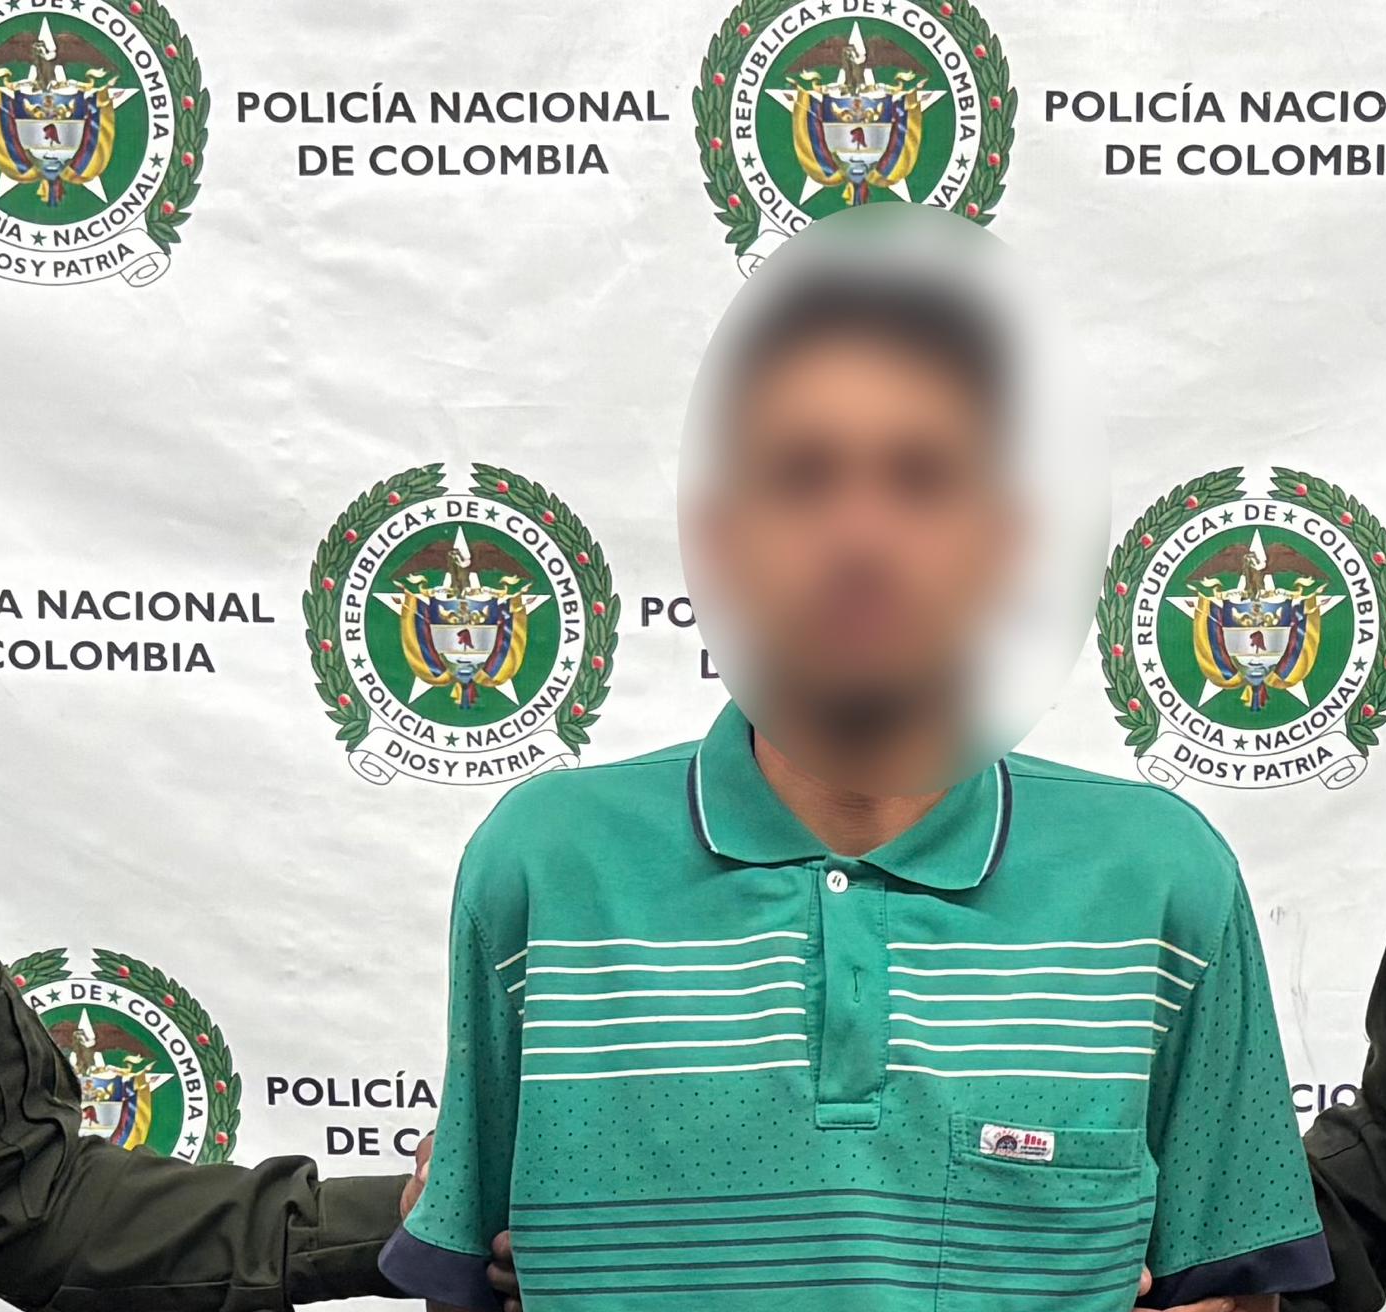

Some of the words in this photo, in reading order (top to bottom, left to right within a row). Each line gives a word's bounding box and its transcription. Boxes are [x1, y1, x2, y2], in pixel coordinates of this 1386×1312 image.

[92, 6, 169, 140] COLOMBIA
[238, 83, 416, 123] POLICÍA
[431, 90, 669, 123] NACIONAL
[1046, 83, 1225, 122] POLICÍA
[299, 145, 353, 176] DE
[369, 144, 608, 175] COLOMBIA
[1106, 145, 1161, 175] DE
[53, 172, 160, 247] NACIONAL
[53, 243, 135, 278] PATRIA
[446, 500, 479, 519] DE
[506, 516, 580, 644] COLOMBIA
[1244, 503, 1277, 521] DE
[1303, 517, 1374, 645] COLOMBIA
[38, 590, 274, 622] NACIONAL
[466, 675, 571, 748] NACIONAL
[1255, 676, 1362, 750] NACIONAL
[466, 744, 545, 778] PATRIA
[1253, 746, 1334, 780] PATRIA
[267, 1071, 437, 1108] POLICÍA
[327, 1127, 380, 1155] DE
